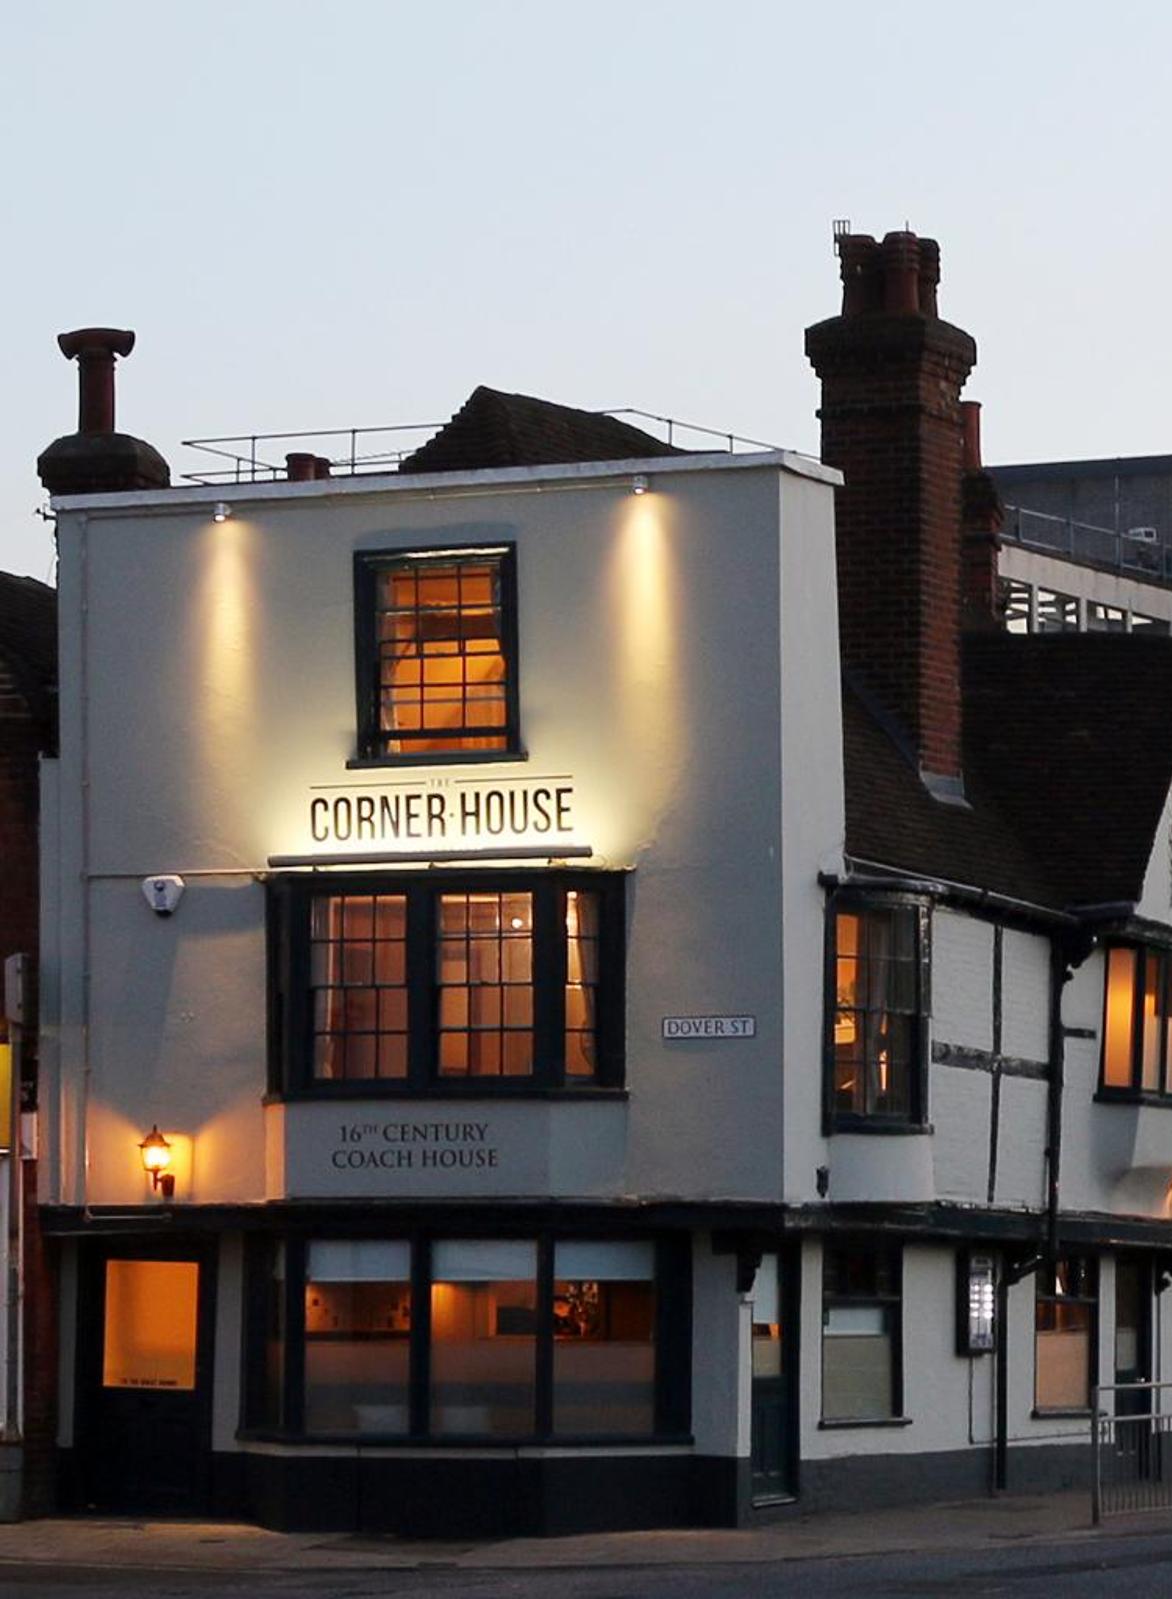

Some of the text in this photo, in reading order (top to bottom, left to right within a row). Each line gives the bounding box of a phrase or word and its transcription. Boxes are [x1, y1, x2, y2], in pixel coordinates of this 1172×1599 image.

[310, 788, 574, 842] CORNER HOUSE
[667, 1019, 749, 1035] DOVER ST
[382, 1123, 489, 1143] CENTURY
[332, 1149, 498, 1169] COACH HOUSE
